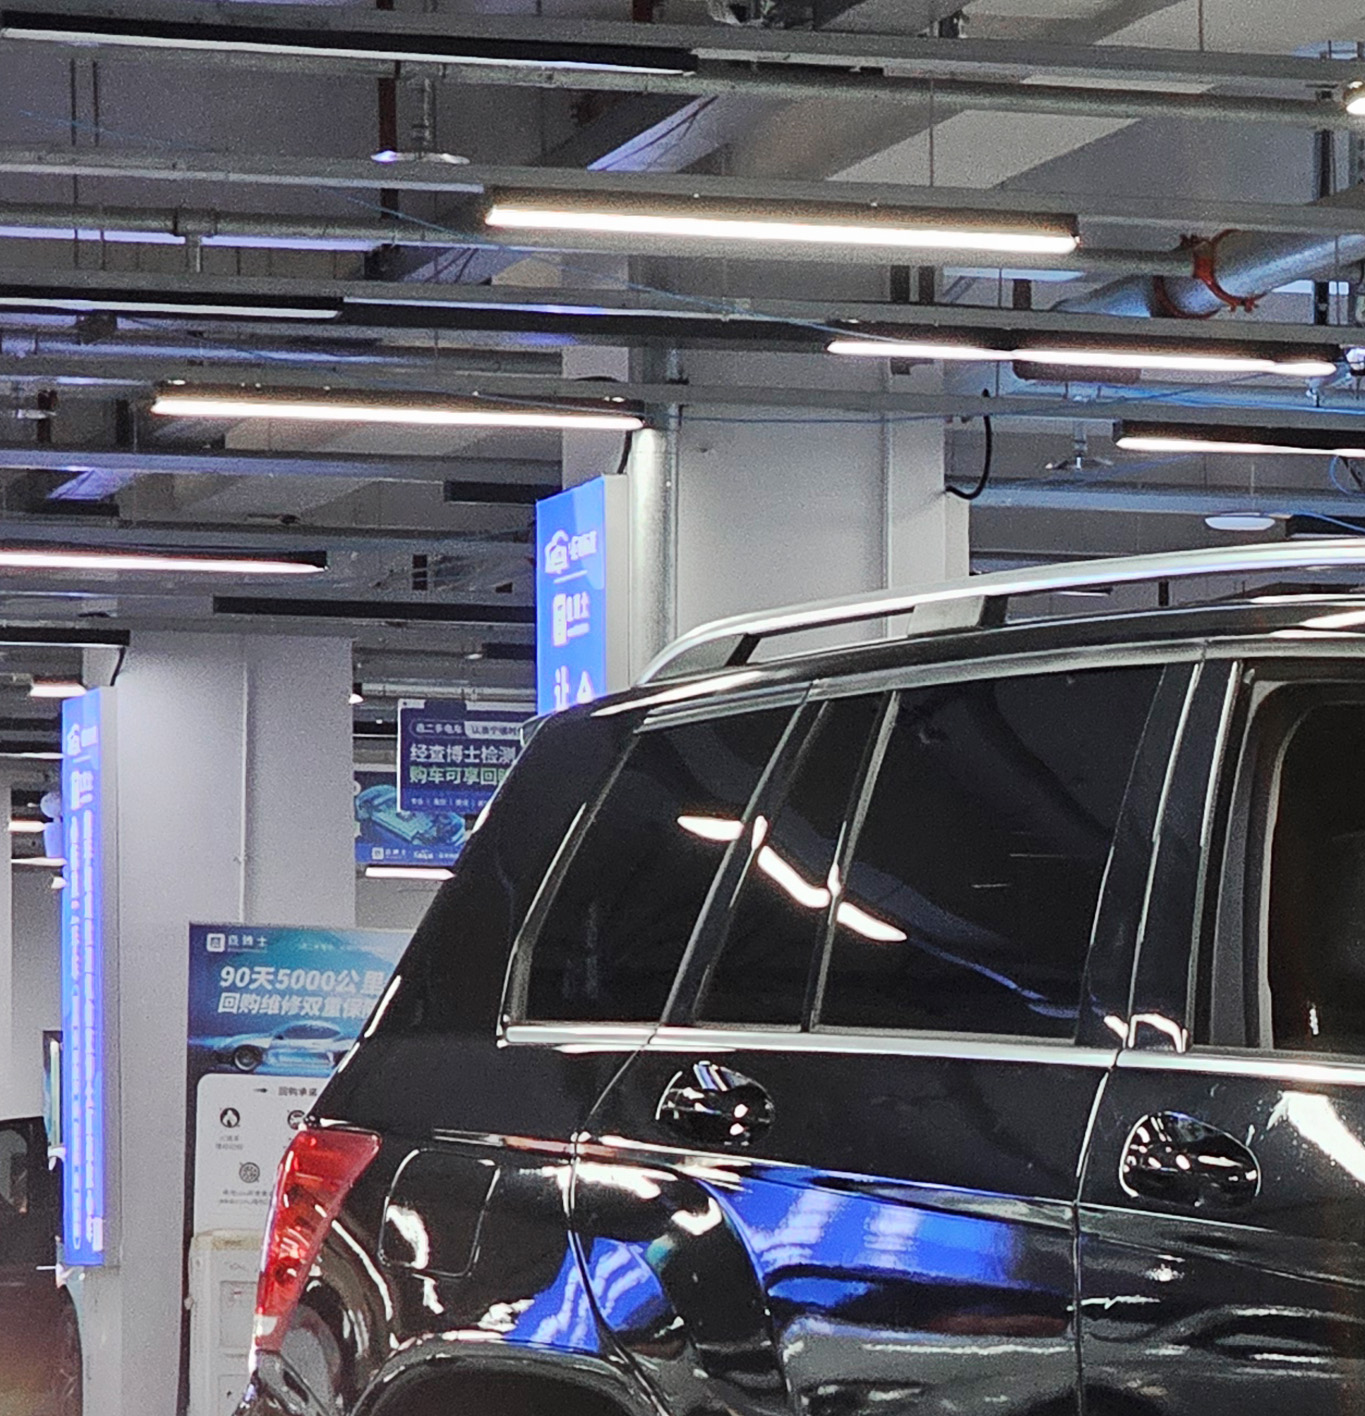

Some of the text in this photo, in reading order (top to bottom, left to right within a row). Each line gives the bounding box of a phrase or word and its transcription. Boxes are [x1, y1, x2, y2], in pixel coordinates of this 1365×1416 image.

[409, 743, 516, 765] 经查博士检测
[220, 966, 386, 996] 90天5000公里
